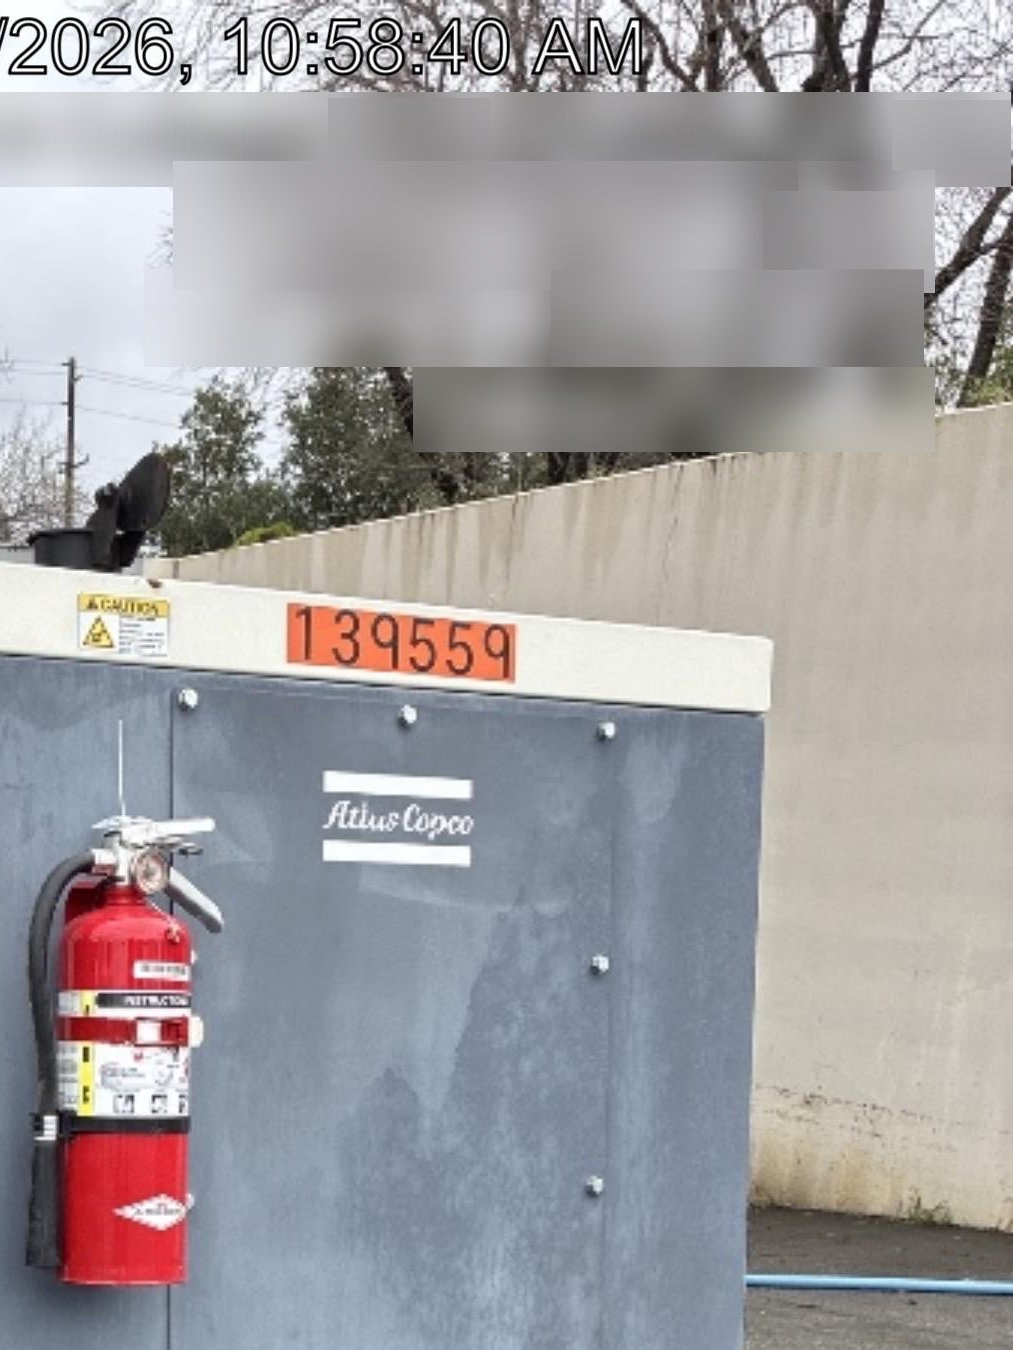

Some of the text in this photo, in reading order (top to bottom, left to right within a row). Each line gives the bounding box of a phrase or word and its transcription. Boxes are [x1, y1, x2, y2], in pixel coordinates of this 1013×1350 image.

[295, 606, 510, 678] 139559
[323, 801, 474, 840] Atlas Copco
